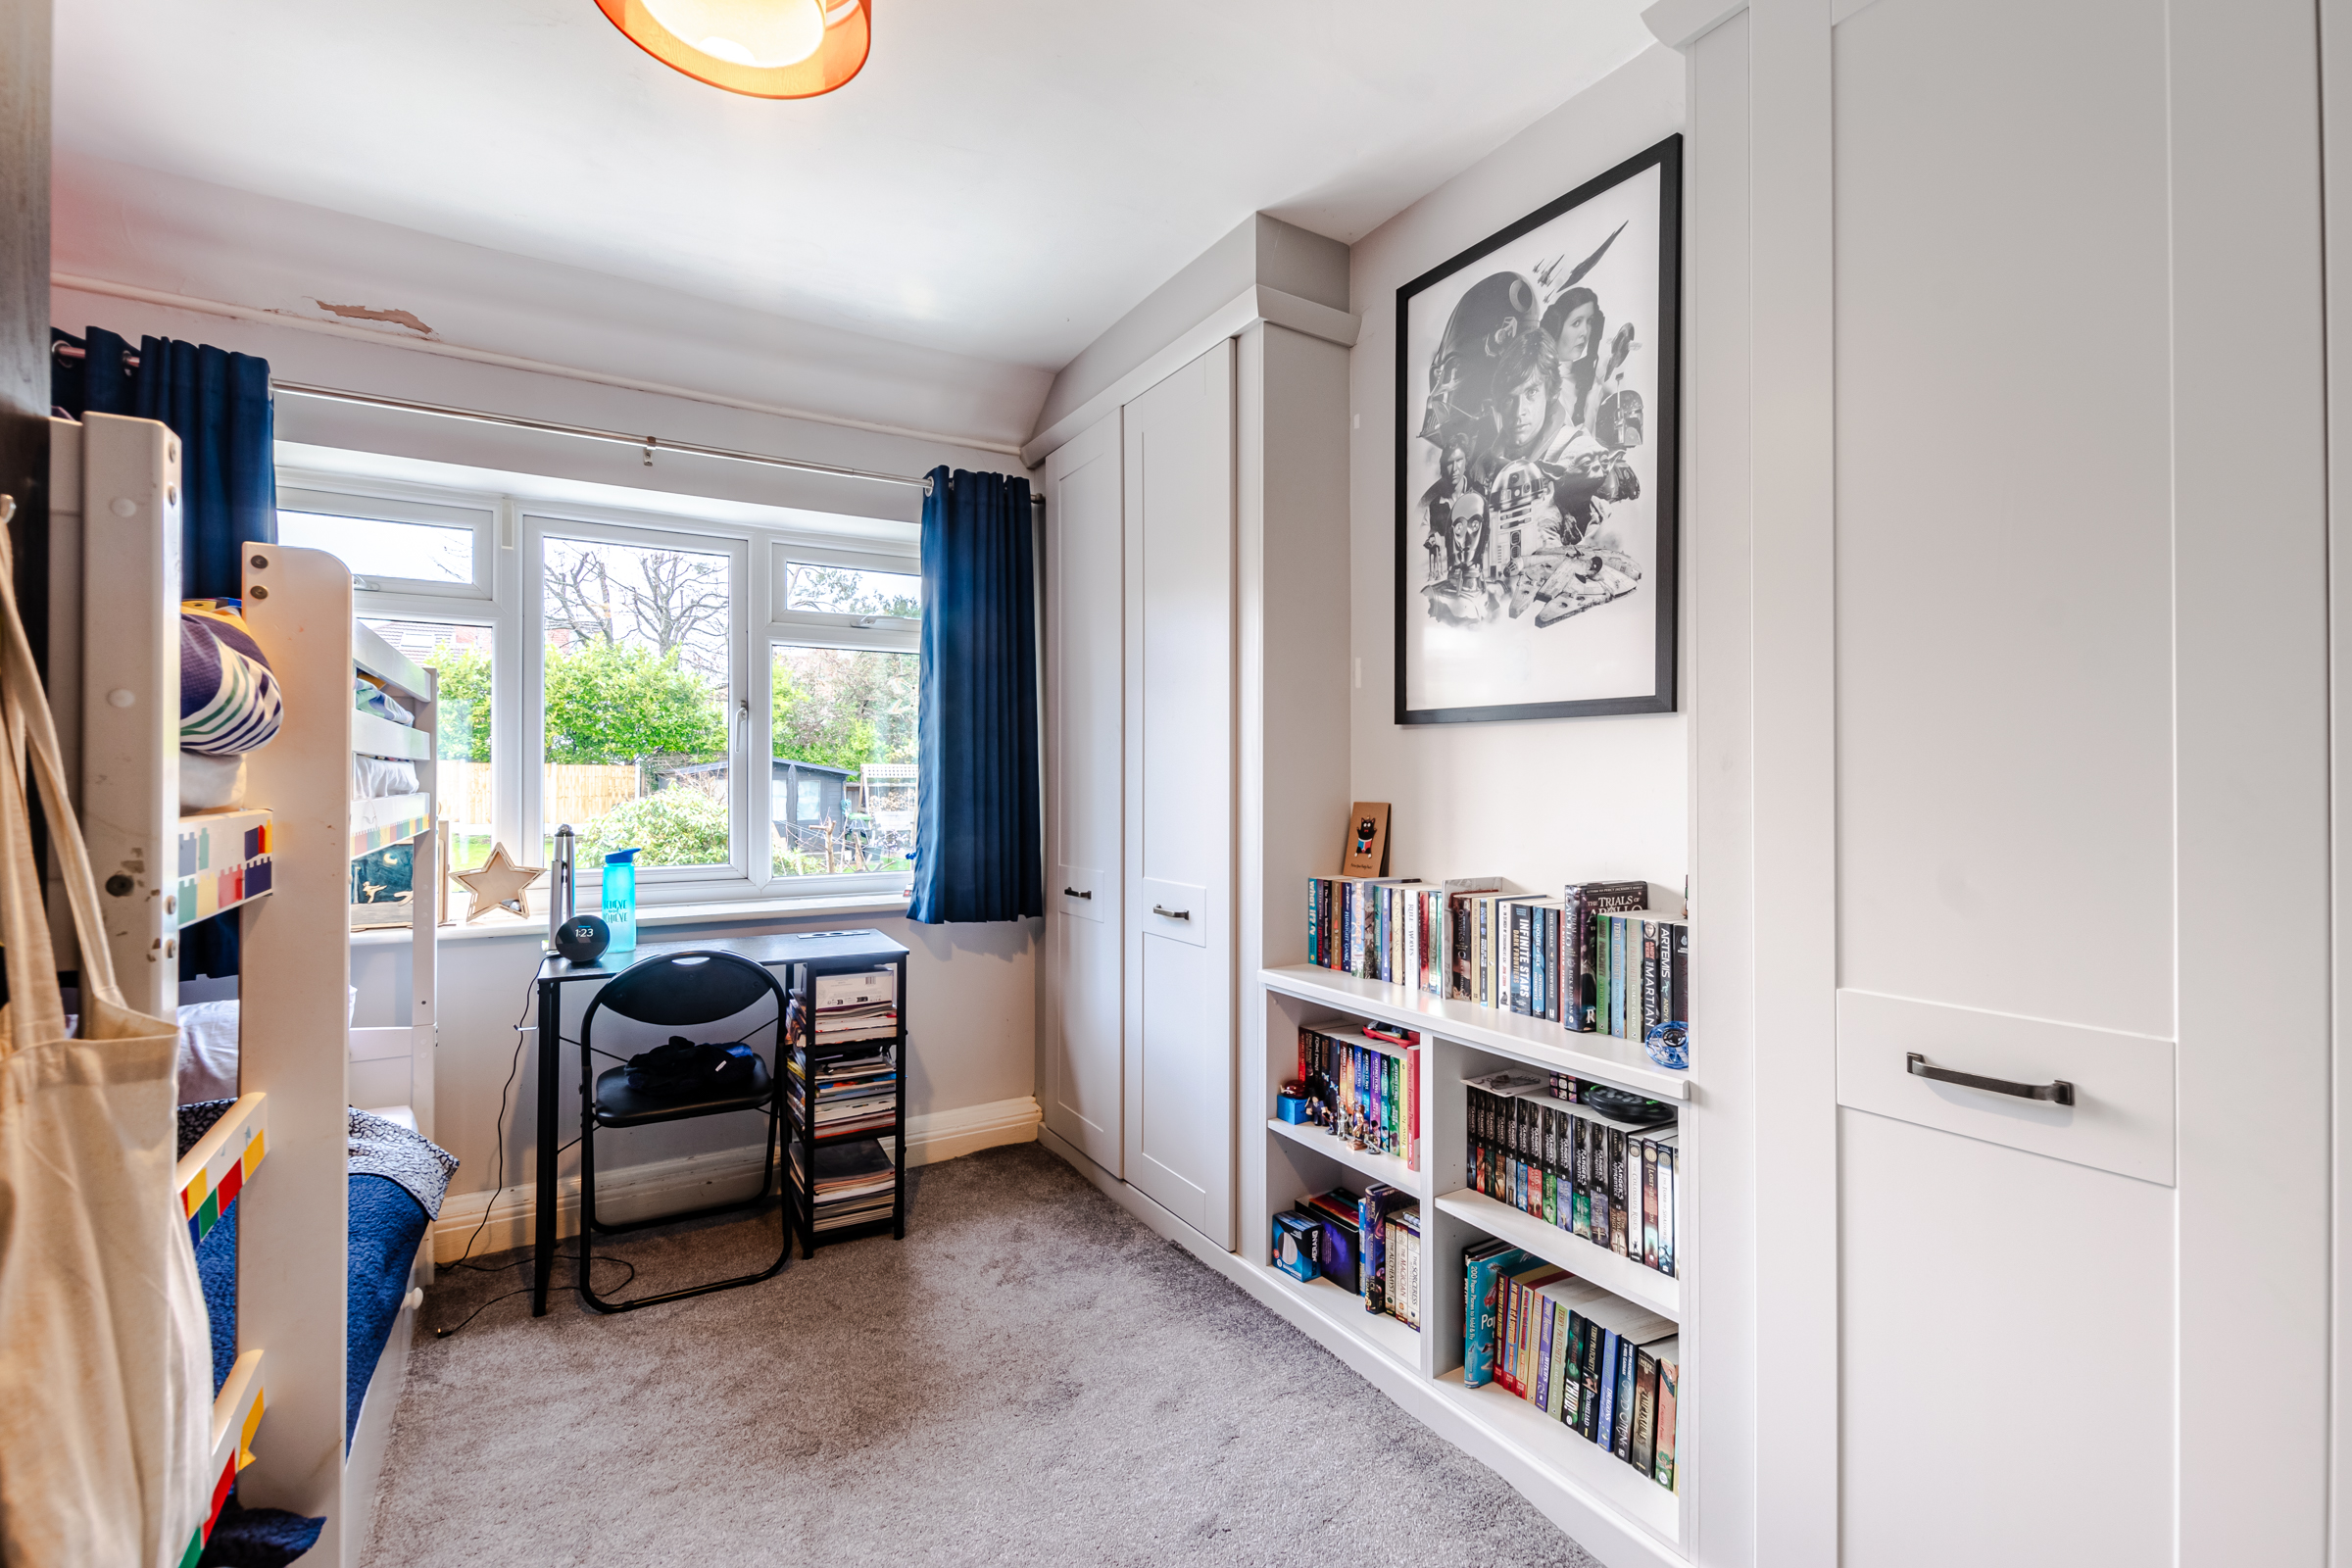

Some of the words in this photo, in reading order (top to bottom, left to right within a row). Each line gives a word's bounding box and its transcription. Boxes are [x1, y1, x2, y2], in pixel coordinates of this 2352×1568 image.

[1598, 895, 1633, 907] TRIALS
[575, 929, 593, 937] 1:23
[1519, 918, 1530, 964] INFINITE
[1661, 928, 1670, 978] ARTEMIS
[1519, 966, 1529, 998] STARS
[1645, 966, 1655, 1027] MARTIAN
[1554, 1328, 1564, 1364] PRATCHETT
[1588, 1342, 1596, 1372] PRATCHETT
[1564, 1378, 1580, 1415] THUD!
[1584, 1389, 1592, 1426] BROMELIAD
